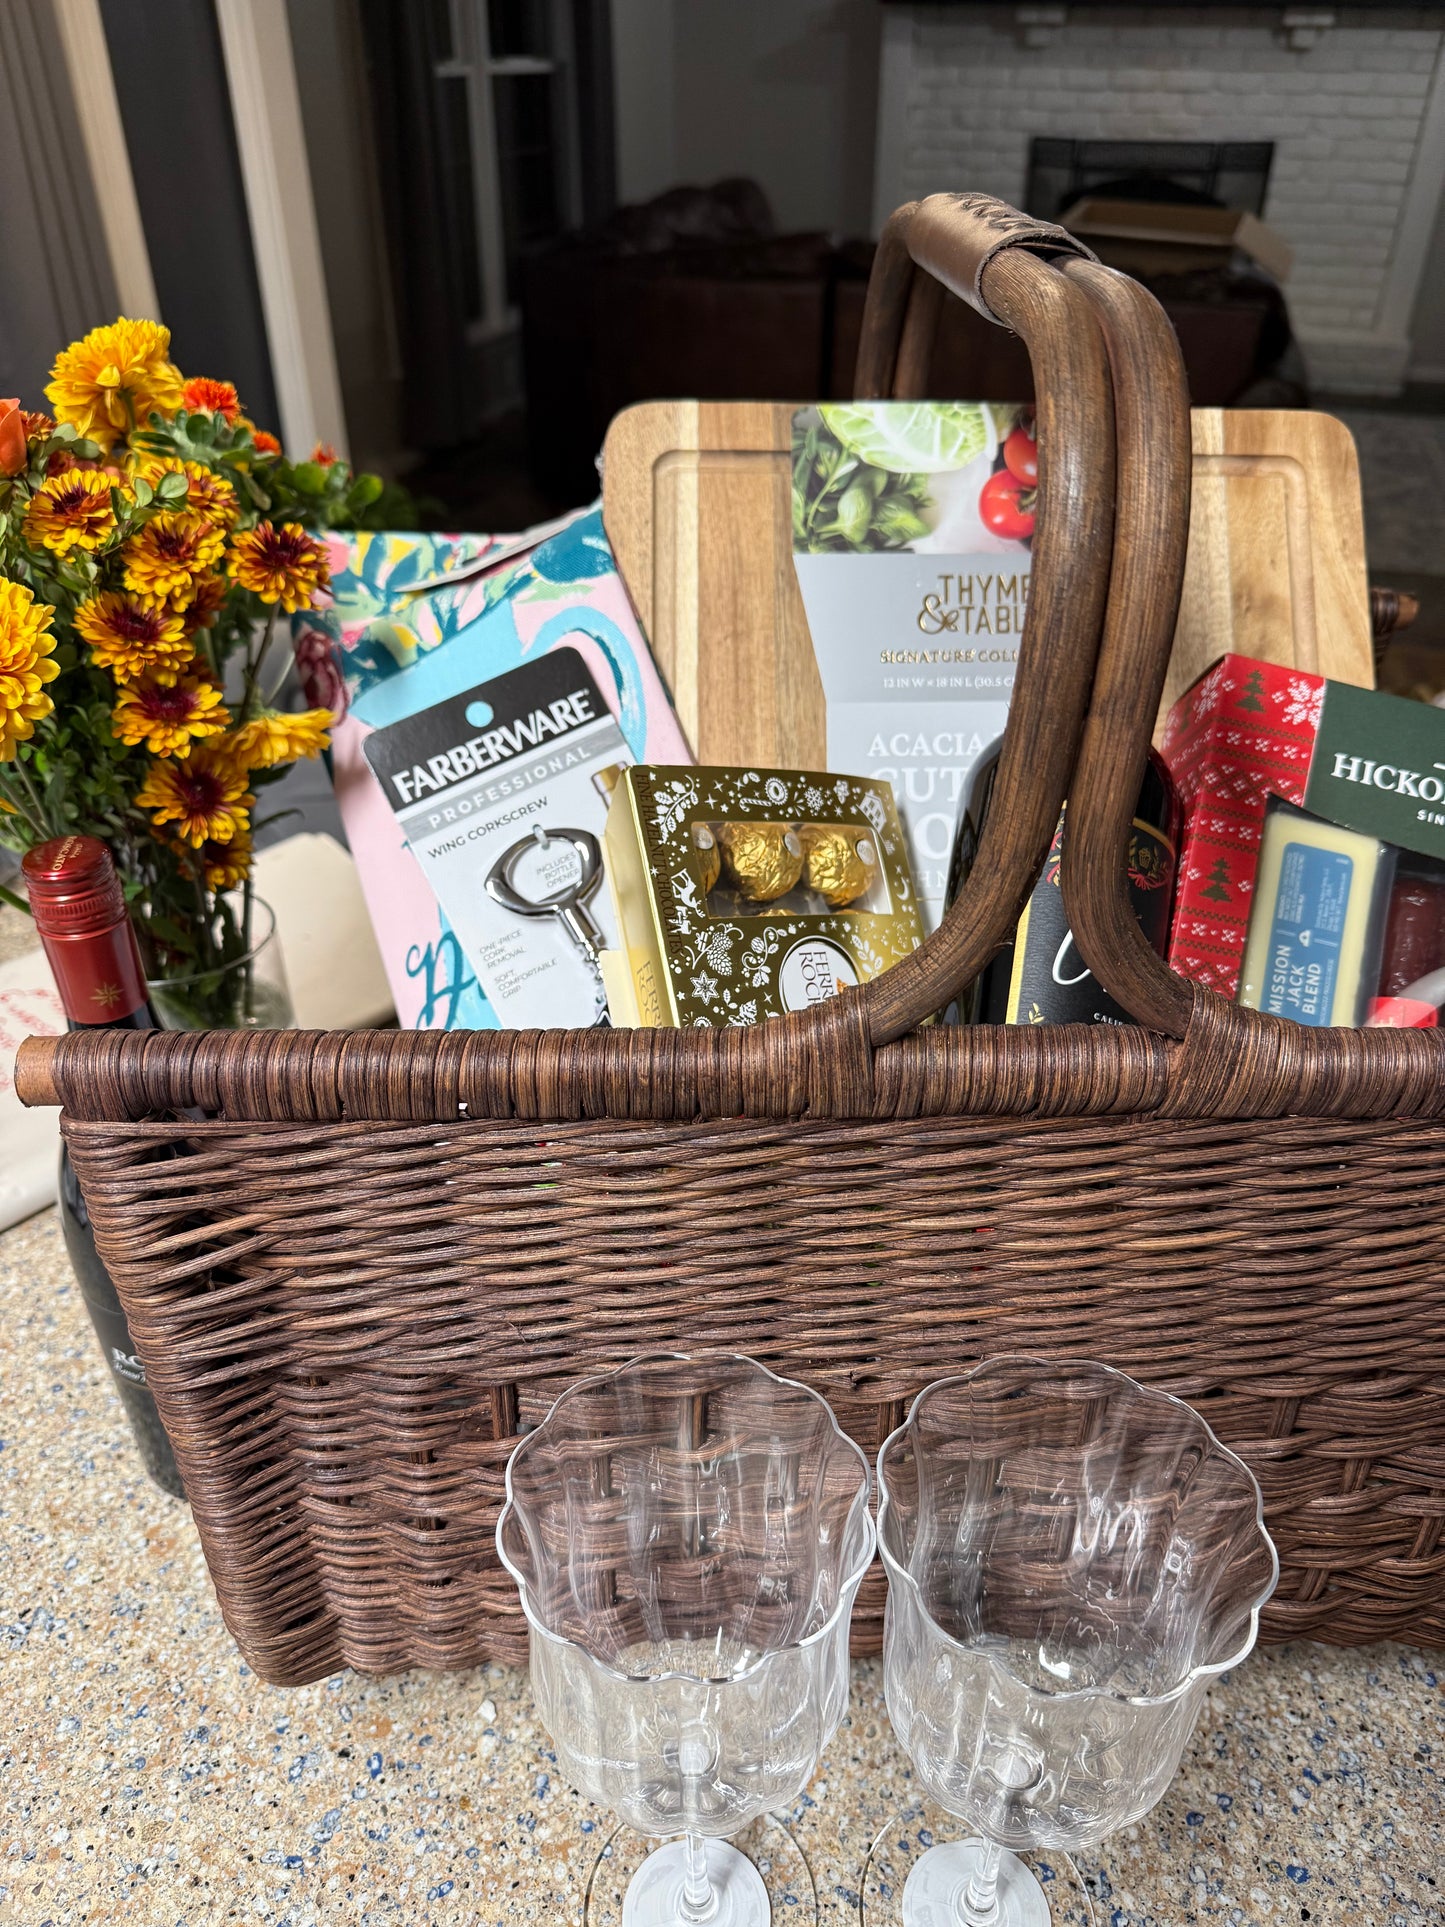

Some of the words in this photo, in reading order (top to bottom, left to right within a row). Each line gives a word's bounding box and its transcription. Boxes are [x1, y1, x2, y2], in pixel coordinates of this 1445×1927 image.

[960, 605, 1024, 635] TABL
[880, 649, 976, 664] SIGNATURE
[897, 677, 909, 688] IN
[911, 677, 925, 688] W
[950, 677, 962, 688] IN
[965, 677, 972, 688] L
[1003, 677, 1016, 688] C
[391, 694, 595, 803] FARBERWARE
[867, 733, 986, 757] ACACIA
[428, 747, 591, 828] PROFESSIONAL
[635, 773, 651, 803] FINE
[1330, 752, 1445, 805] HICKO
[428, 836, 466, 859] WING
[467, 796, 548, 841] CORKSCREW
[1416, 809, 1445, 826] SIN
[642, 803, 669, 872] HAZELNUT
[536, 851, 576, 876] INCLUDES
[544, 861, 574, 880] BOTTLE
[547, 868, 579, 888] OPENER
[656, 871, 685, 955] CHOCOLATES
[479, 928, 522, 954] ONE-PIECE
[483, 947, 506, 961] CORK
[487, 946, 527, 969] REMOVAL
[494, 969, 515, 984] SOFT
[498, 958, 558, 992] COMFORTABLE
[813, 951, 834, 999] FERR
[1268, 945, 1291, 1014] MISSION
[1286, 964, 1305, 1007] JACK
[1302, 963, 1321, 1015] BLEND
[502, 985, 522, 999] GRIP
[636, 967, 654, 1026] ROC
[643, 960, 662, 1027] FERR
